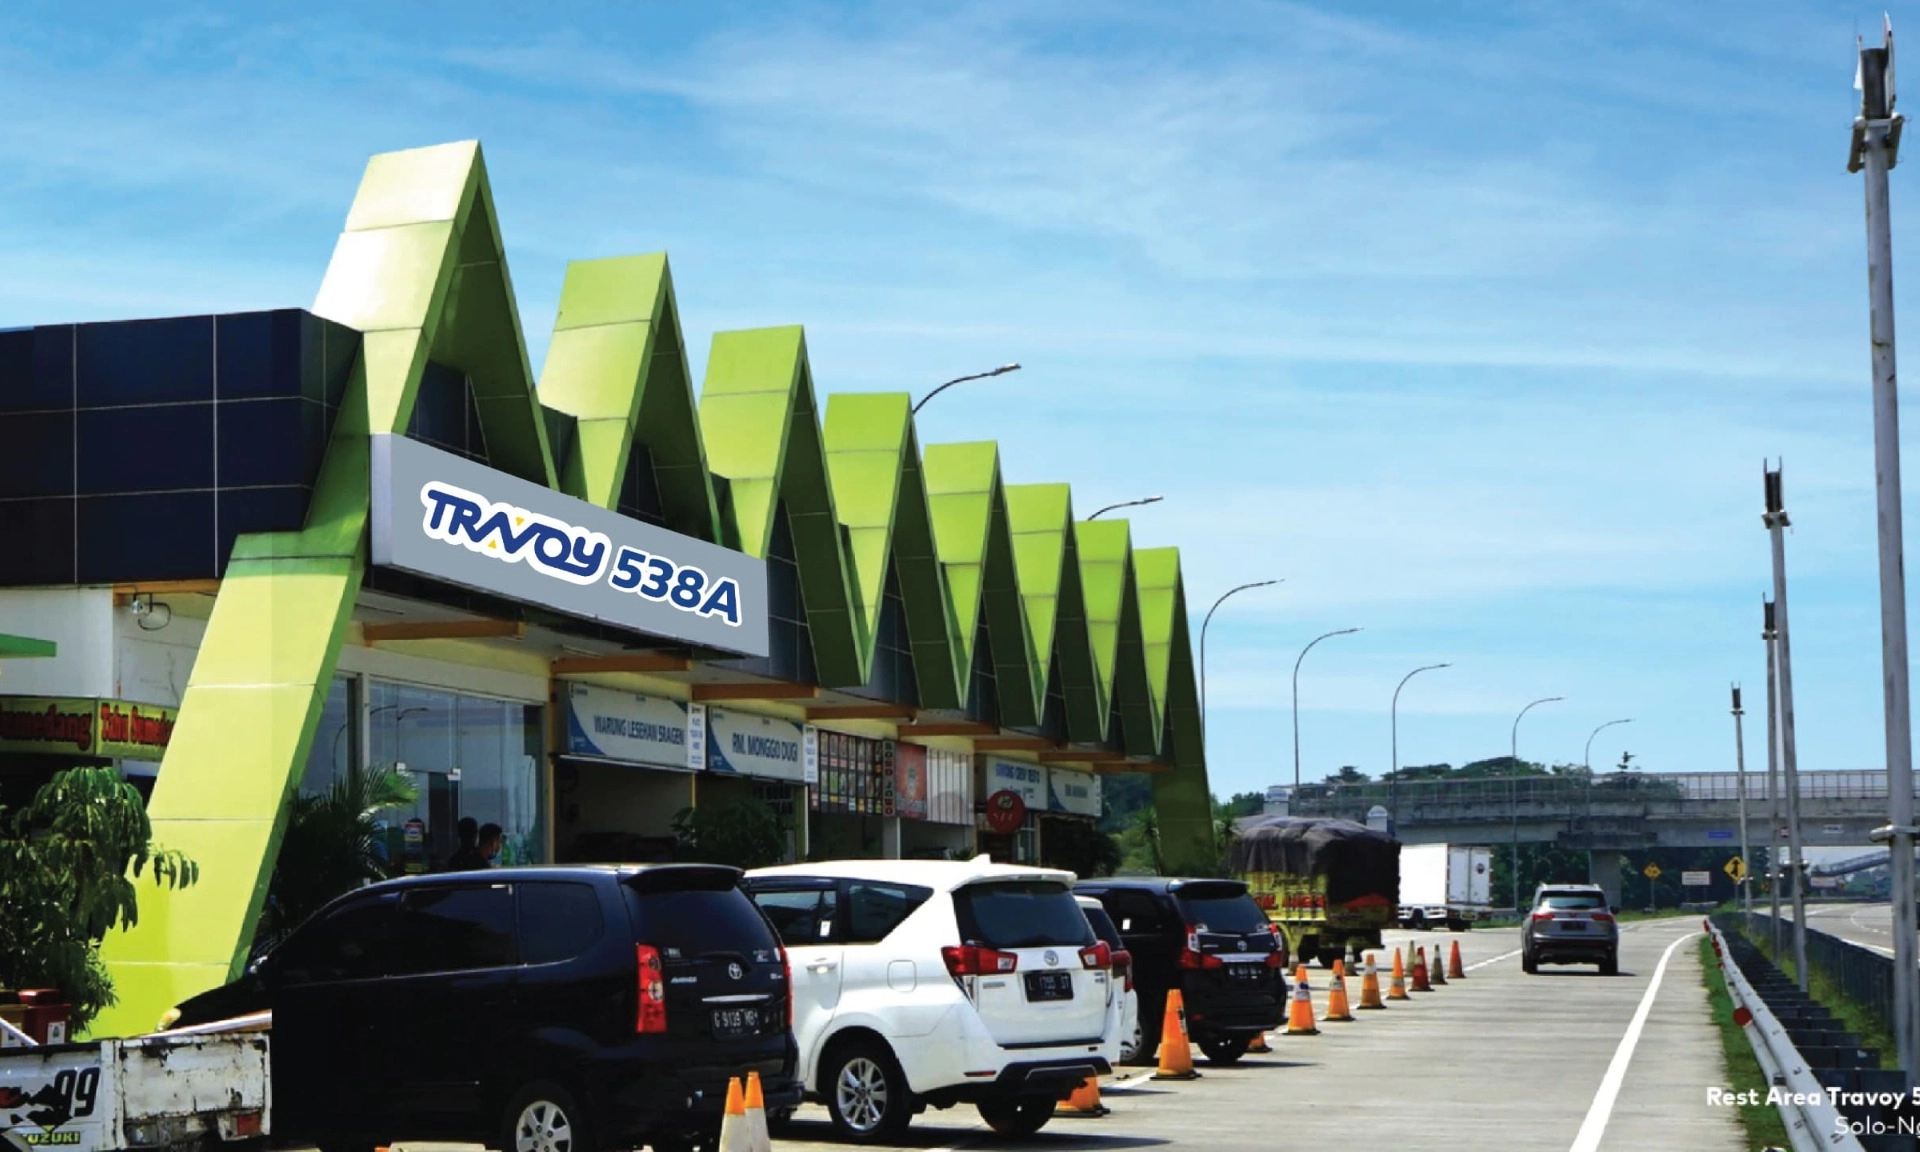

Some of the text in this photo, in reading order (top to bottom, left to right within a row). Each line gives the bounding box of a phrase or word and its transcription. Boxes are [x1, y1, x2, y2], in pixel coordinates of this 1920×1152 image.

[428, 489, 740, 624] TRAVOY 538A
[0, 702, 93, 751] umedang
[594, 715, 626, 737] WARUNG
[748, 735, 780, 759] MONGGO
[53, 1067, 100, 1117] 99
[23, 1132, 81, 1145] UZUKI
